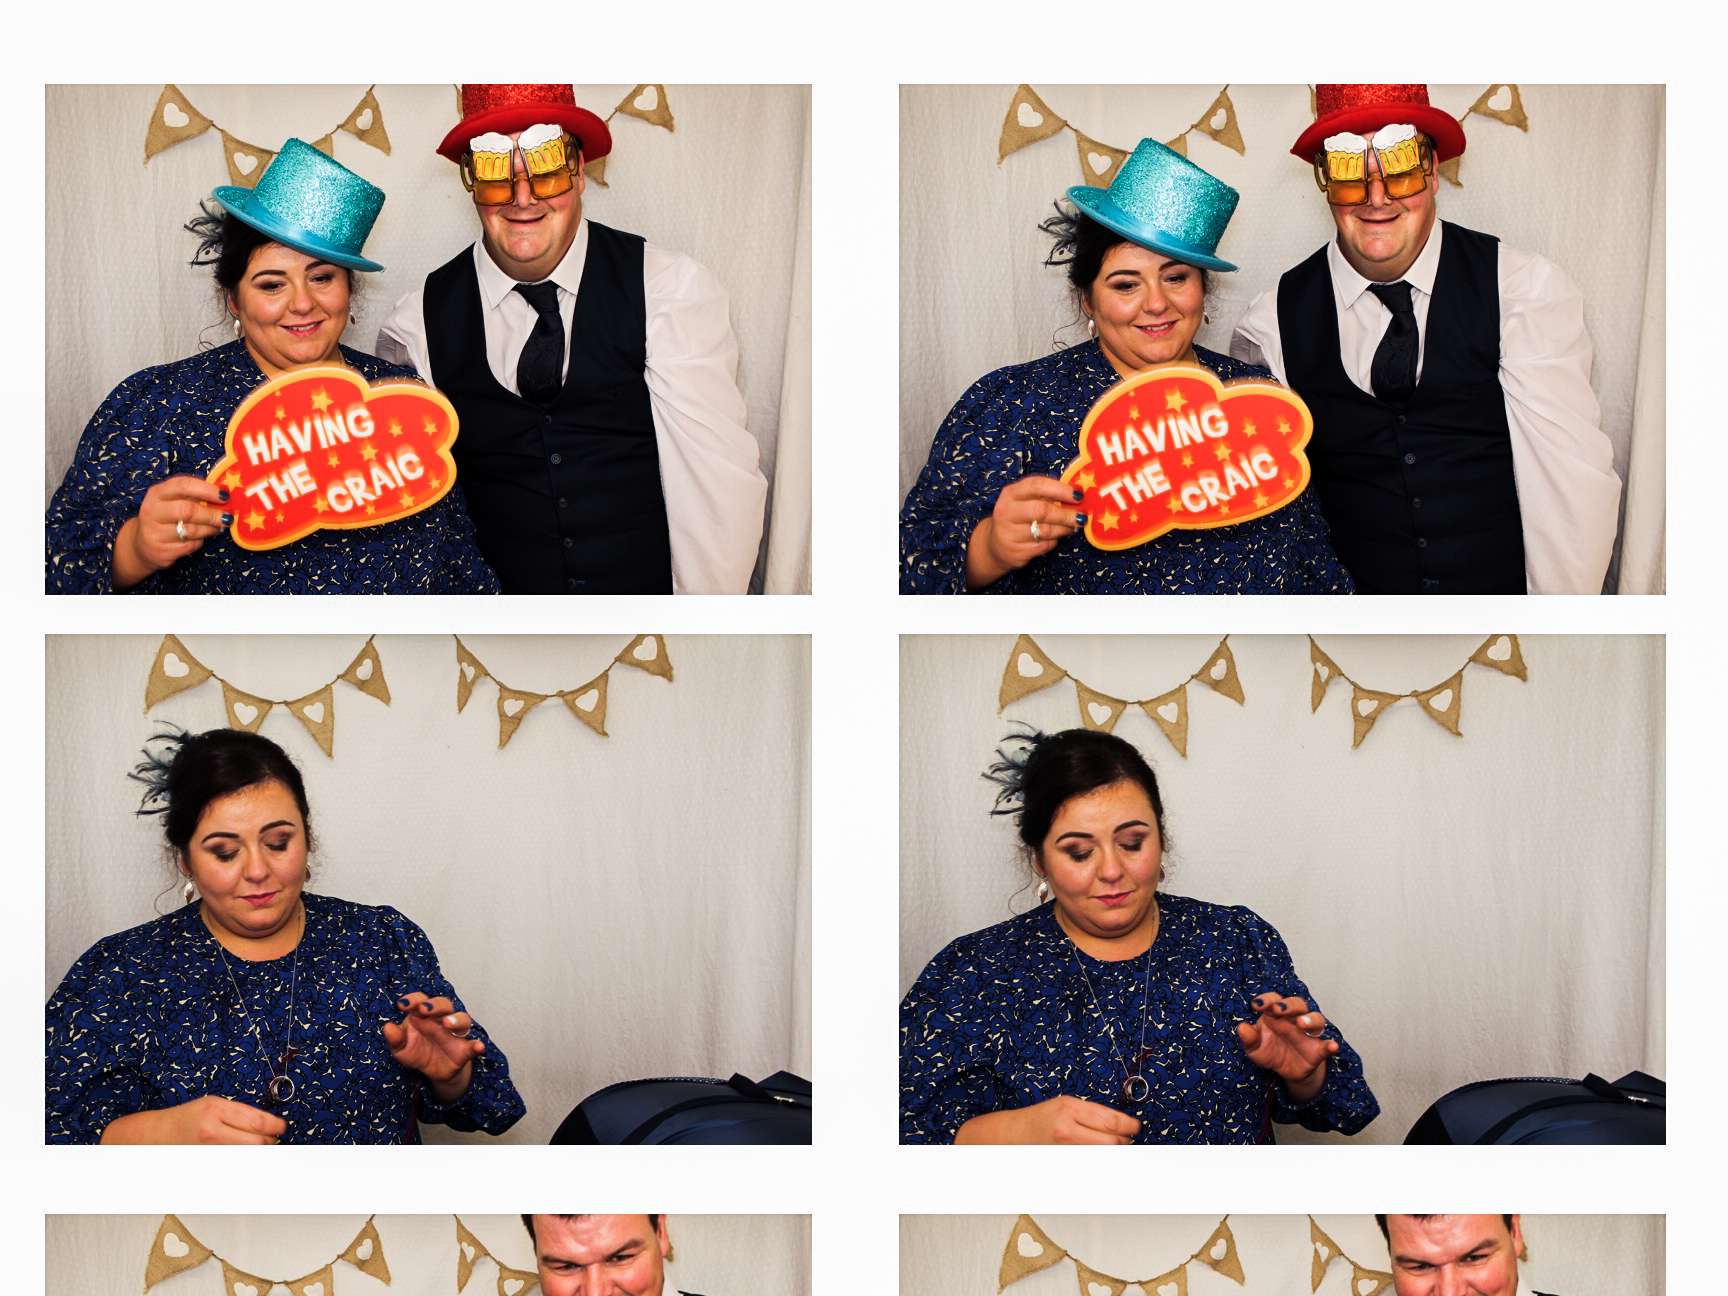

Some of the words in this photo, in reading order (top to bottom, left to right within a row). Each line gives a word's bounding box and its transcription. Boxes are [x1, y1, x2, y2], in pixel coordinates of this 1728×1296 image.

[242, 408, 375, 466] HAVING
[1096, 408, 1229, 466] HAVING
[245, 462, 318, 511] THE
[327, 452, 424, 513] CRAIC
[1099, 462, 1172, 511] THE
[1181, 452, 1278, 513] CRAIC
